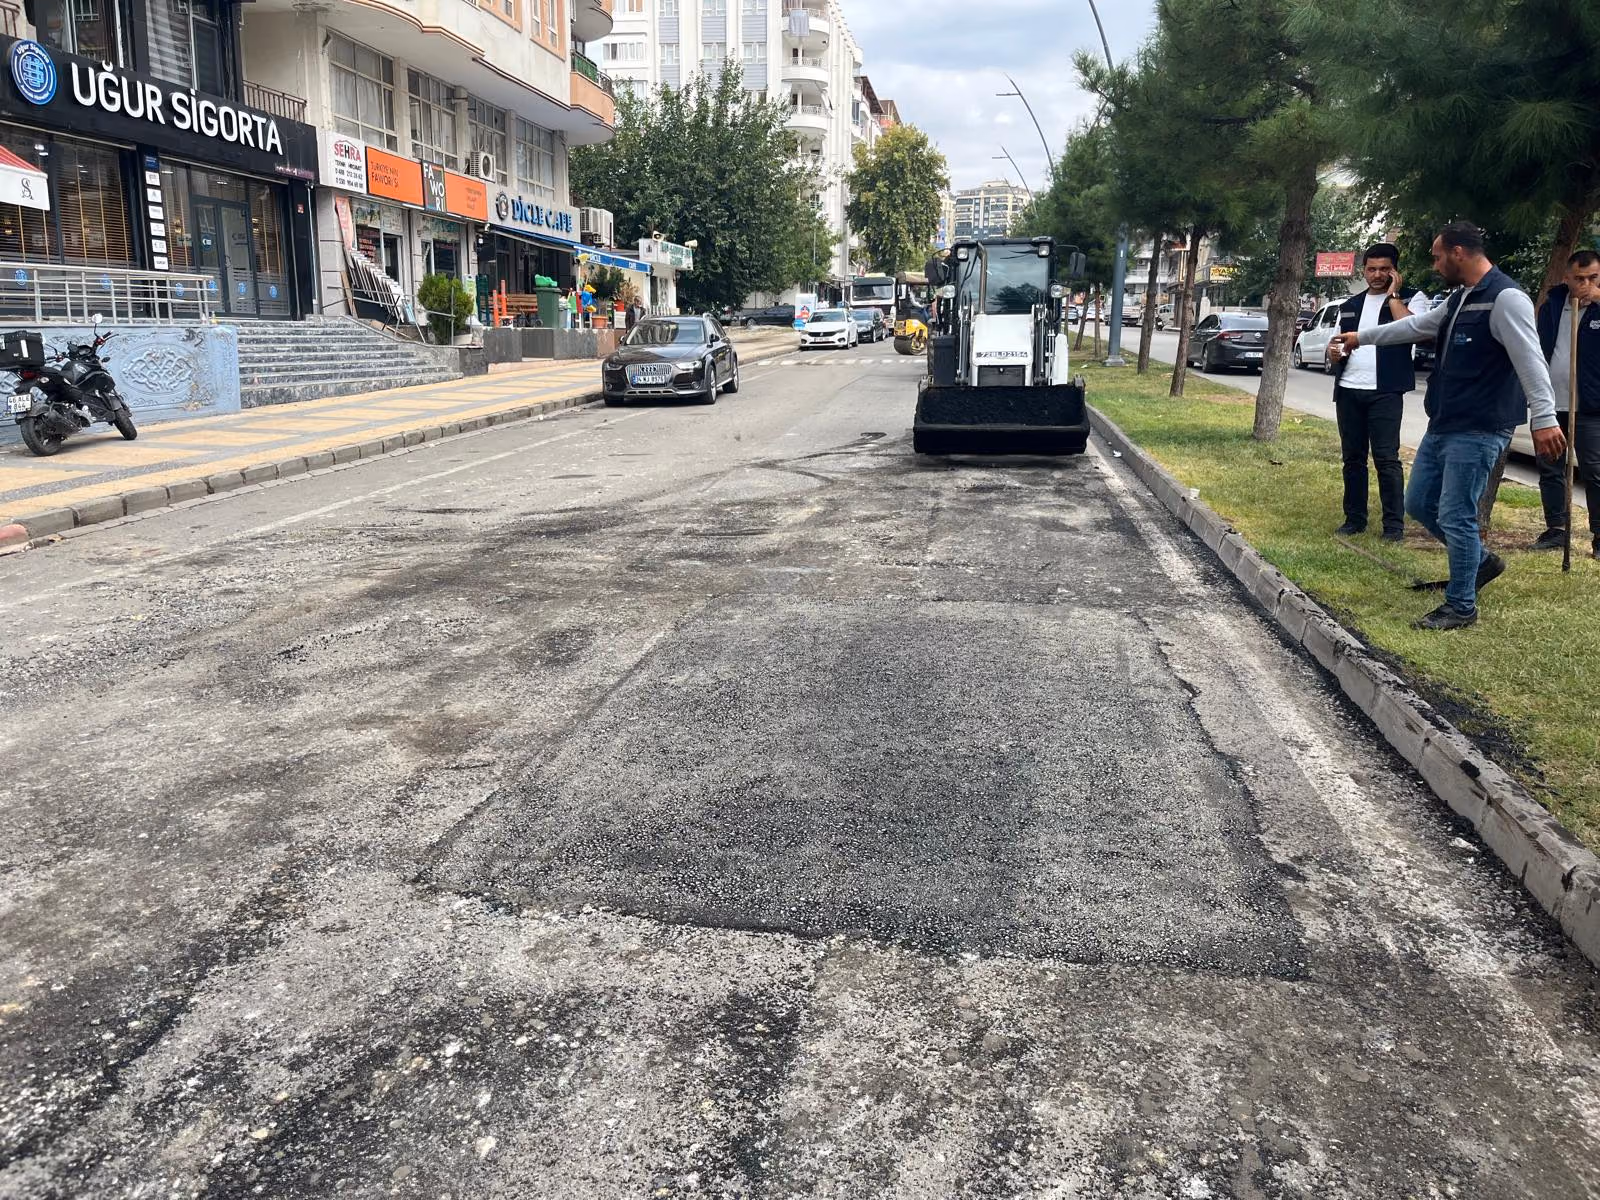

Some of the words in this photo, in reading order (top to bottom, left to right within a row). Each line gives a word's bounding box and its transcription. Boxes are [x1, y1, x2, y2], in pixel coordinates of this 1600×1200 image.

[71, 59, 166, 125] UĞUR
[171, 88, 283, 156] SİGORTA
[334, 143, 362, 162] SEHRA
